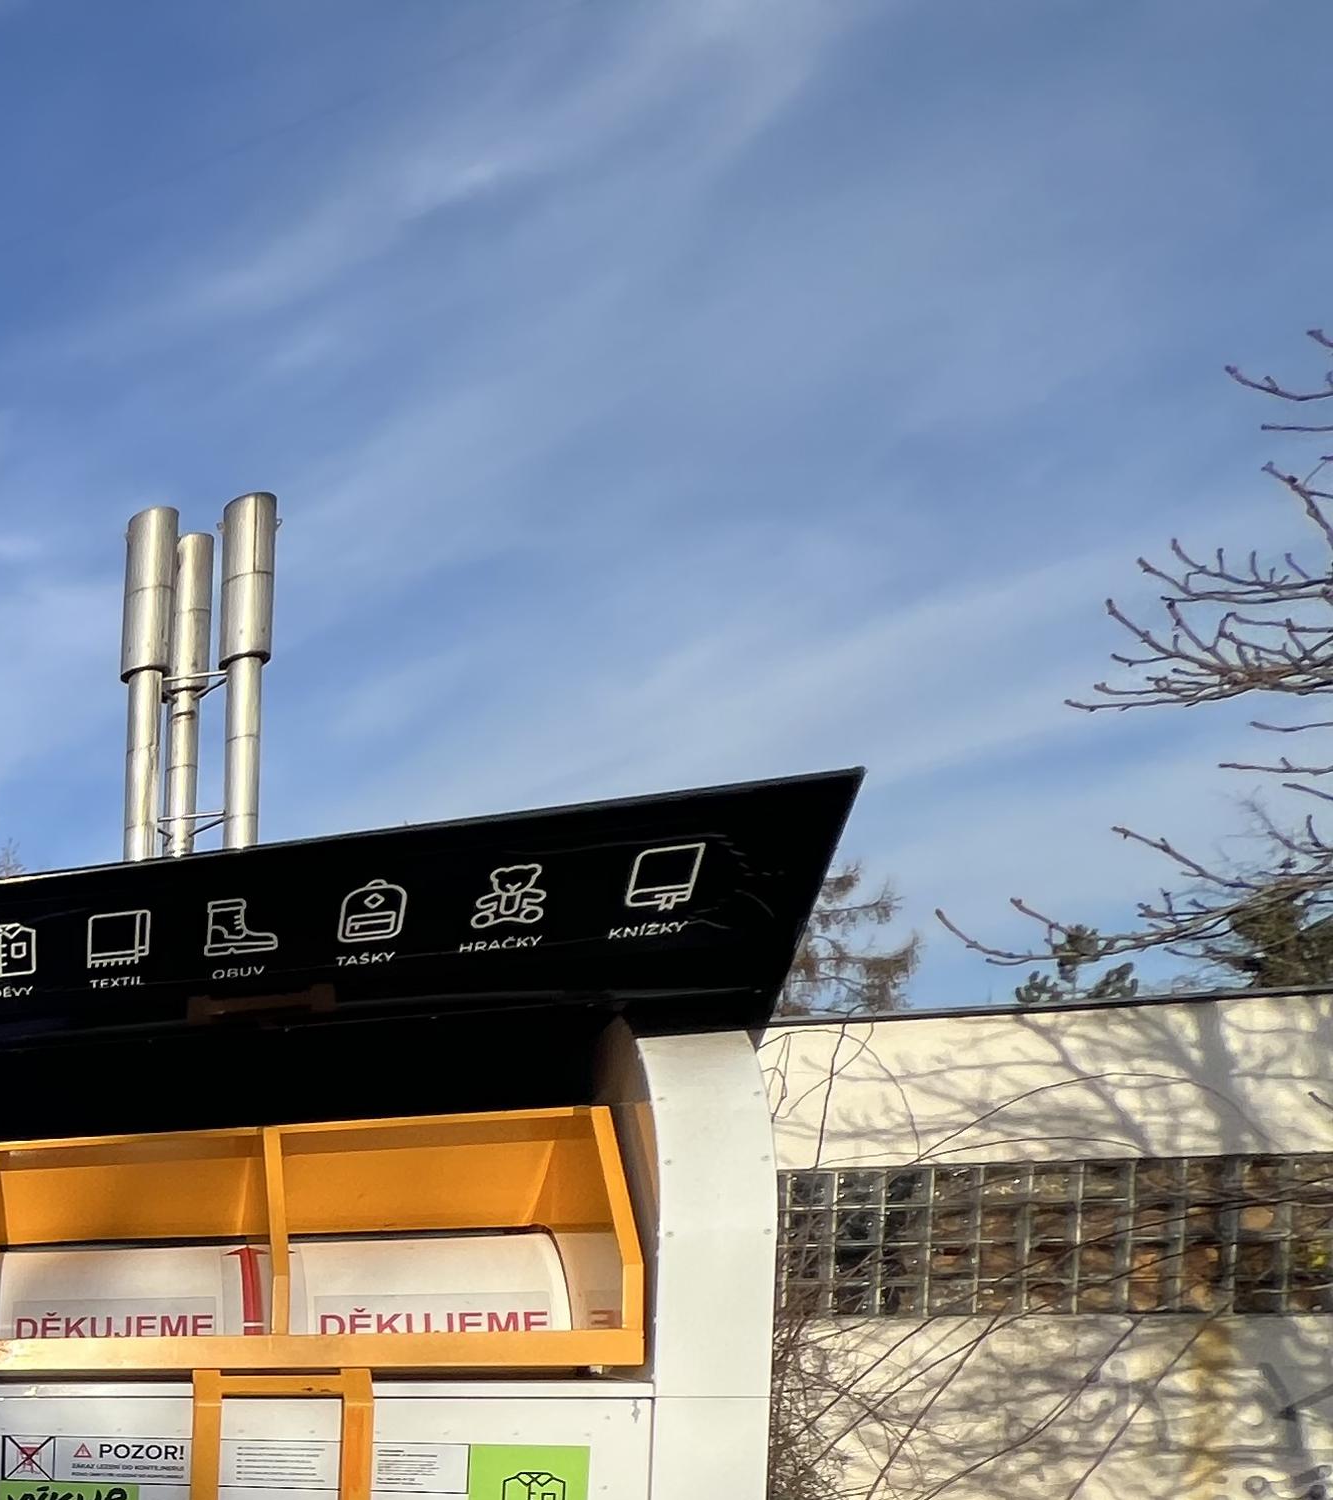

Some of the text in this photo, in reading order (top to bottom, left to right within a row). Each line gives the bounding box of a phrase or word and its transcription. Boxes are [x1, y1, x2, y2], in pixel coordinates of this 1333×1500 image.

[607, 920, 690, 940] KNÍŽKY
[458, 935, 543, 953] HRAČKY
[335, 951, 396, 967] TAŠKY
[212, 965, 266, 980] OBUV
[89, 976, 147, 990] TEXTIL
[15, 1311, 214, 1339] DĚKUJEME
[319, 1307, 549, 1336] DĚKUJEME
[99, 1443, 185, 1460] POZOR!
